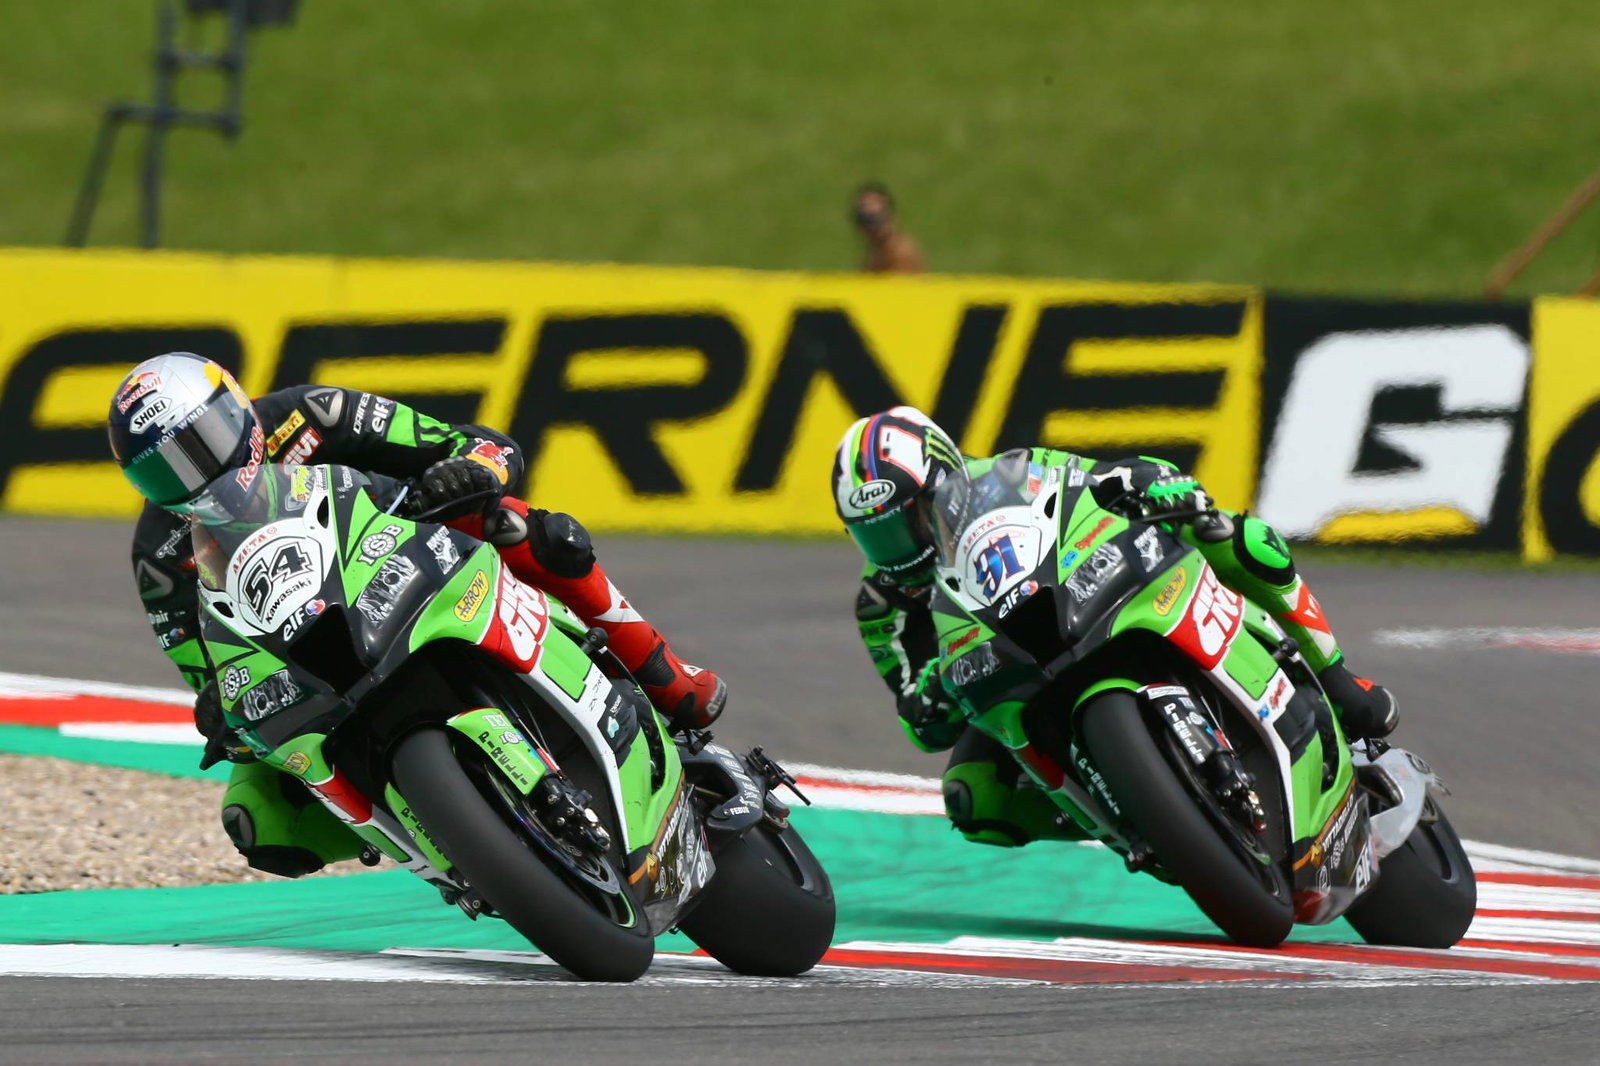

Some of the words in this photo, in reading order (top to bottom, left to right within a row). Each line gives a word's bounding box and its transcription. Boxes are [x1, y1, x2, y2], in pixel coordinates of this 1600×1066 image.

[133, 400, 166, 429] SHOEI
[371, 403, 390, 433] elf
[155, 430, 177, 448] YOU
[856, 481, 887, 504] Arai
[232, 534, 270, 576] AZETA
[973, 533, 1026, 604] 91
[243, 541, 315, 624] 54
[265, 578, 313, 625] Kawasaki
[457, 572, 486, 616] ARROW
[283, 610, 306, 642] elf
[999, 590, 1020, 620] elf
[1164, 702, 1206, 765] PIRELLI
[478, 730, 529, 786] PIRELLI
